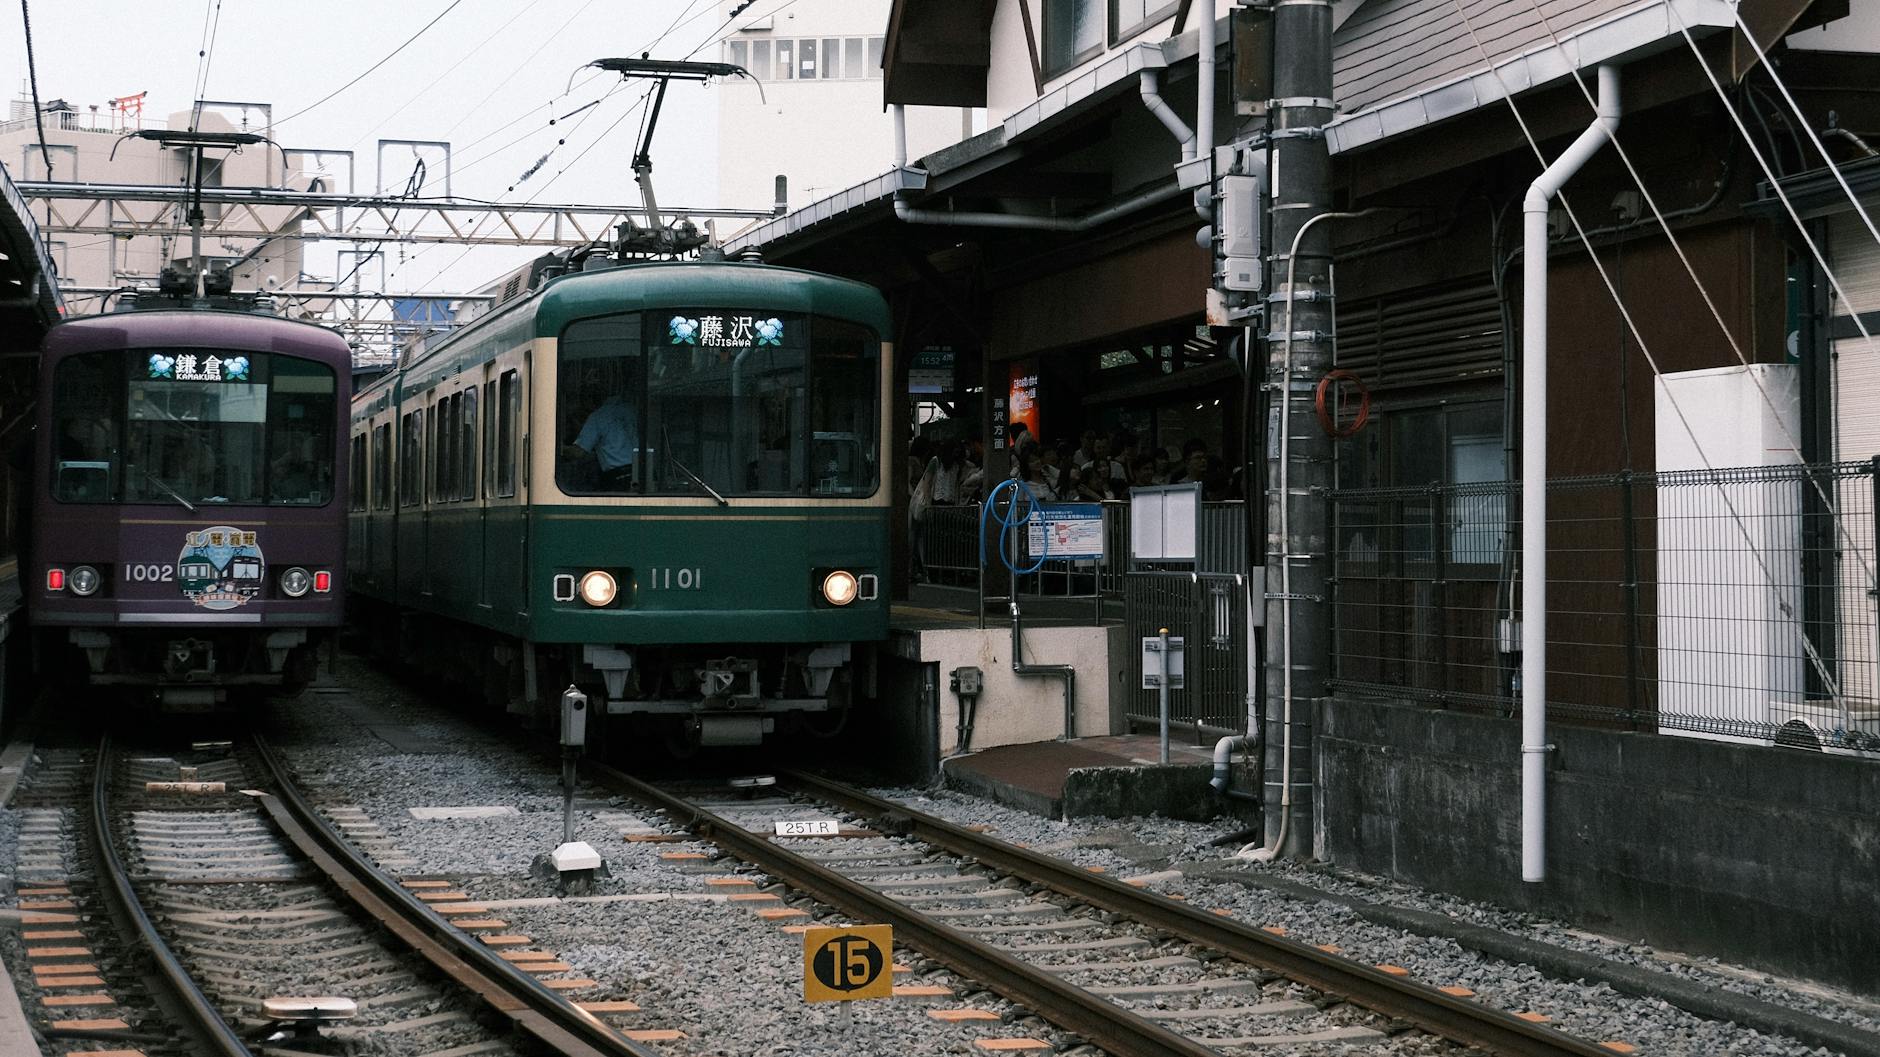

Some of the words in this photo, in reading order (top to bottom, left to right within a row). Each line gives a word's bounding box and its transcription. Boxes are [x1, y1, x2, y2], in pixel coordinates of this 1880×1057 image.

[699, 315, 753, 340] 藤沢
[701, 338, 751, 347] FUJISAWA
[175, 353, 223, 375] 鎌倉
[176, 373, 222, 381] KAMAKURA
[993, 398, 1005, 449] 藤沢方面
[125, 564, 173, 582] 1002
[651, 568, 701, 589] 1101
[785, 821, 829, 834] 25T.R
[827, 940, 871, 988] 15
